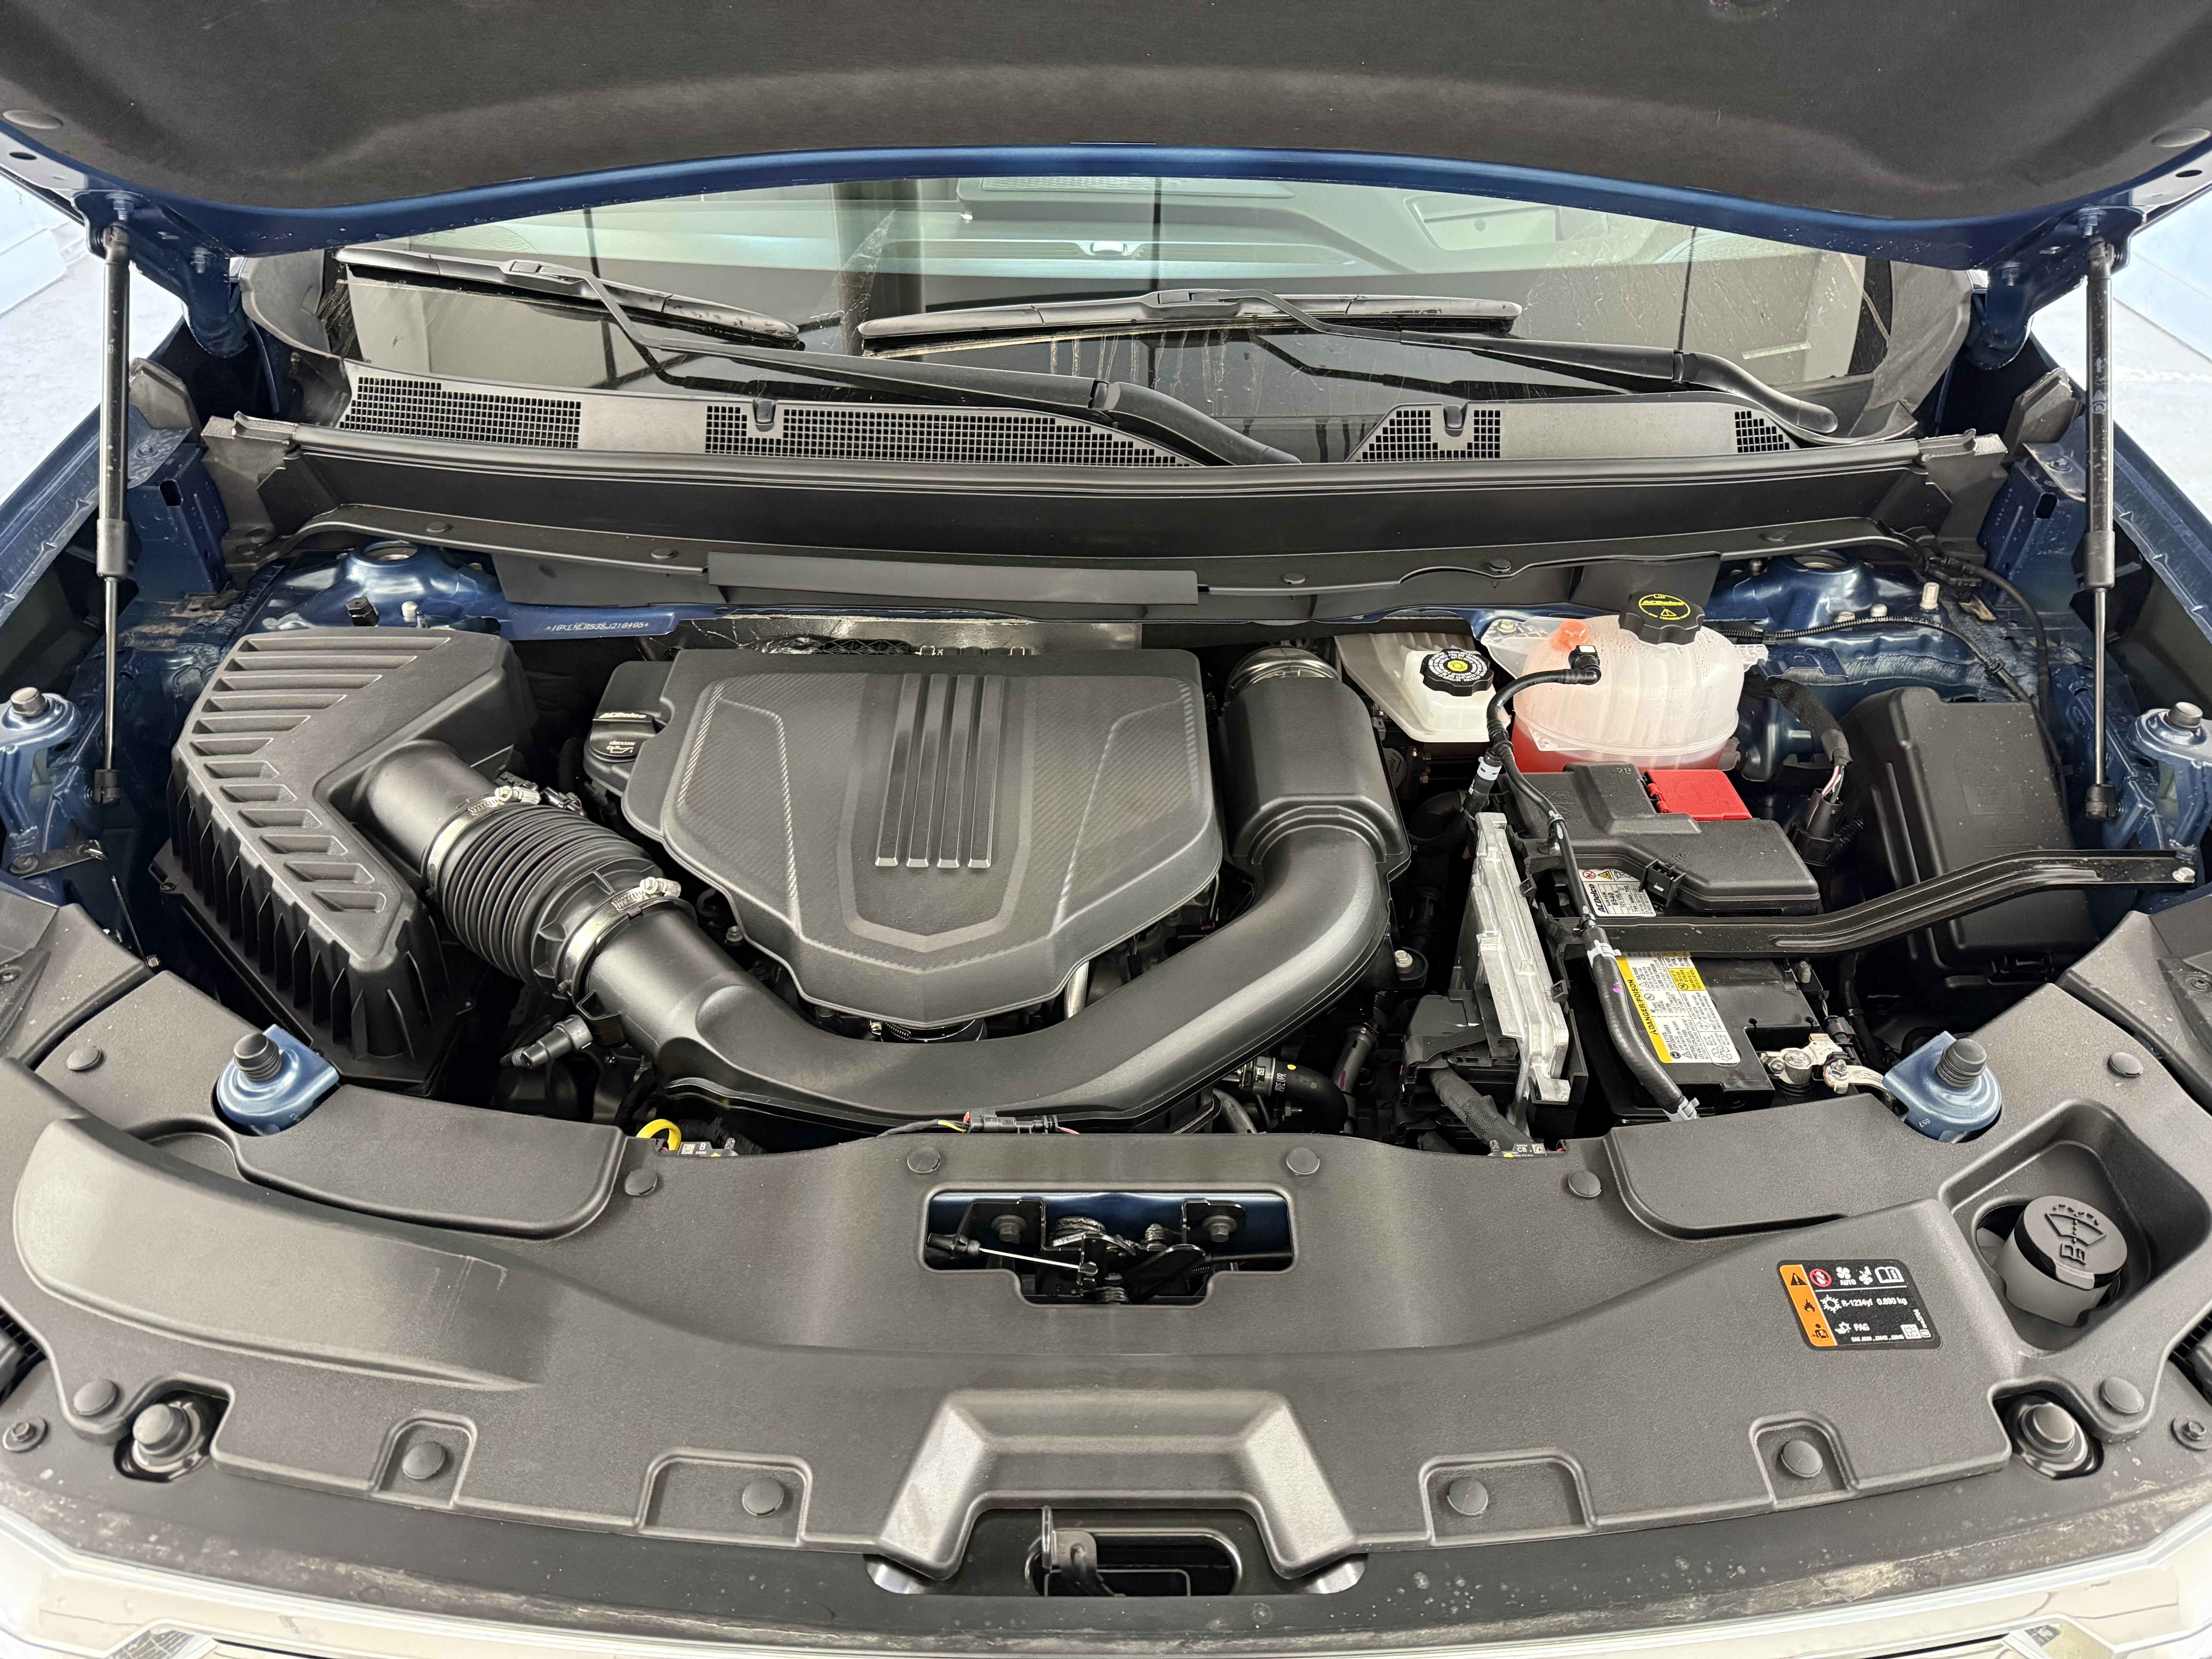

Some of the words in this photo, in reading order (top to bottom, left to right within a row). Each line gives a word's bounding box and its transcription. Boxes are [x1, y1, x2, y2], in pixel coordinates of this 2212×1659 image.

[1589, 884, 1605, 912] ACDelco
[1608, 892, 1618, 905] 8540
[1627, 979, 1654, 1029] DANGER/POISON
[1277, 1073, 1287, 1082] UPR
[1841, 1297, 1874, 1308] R-1234yf
[1897, 1297, 1908, 1305] kg
[1853, 1323, 1870, 1331] PAG
